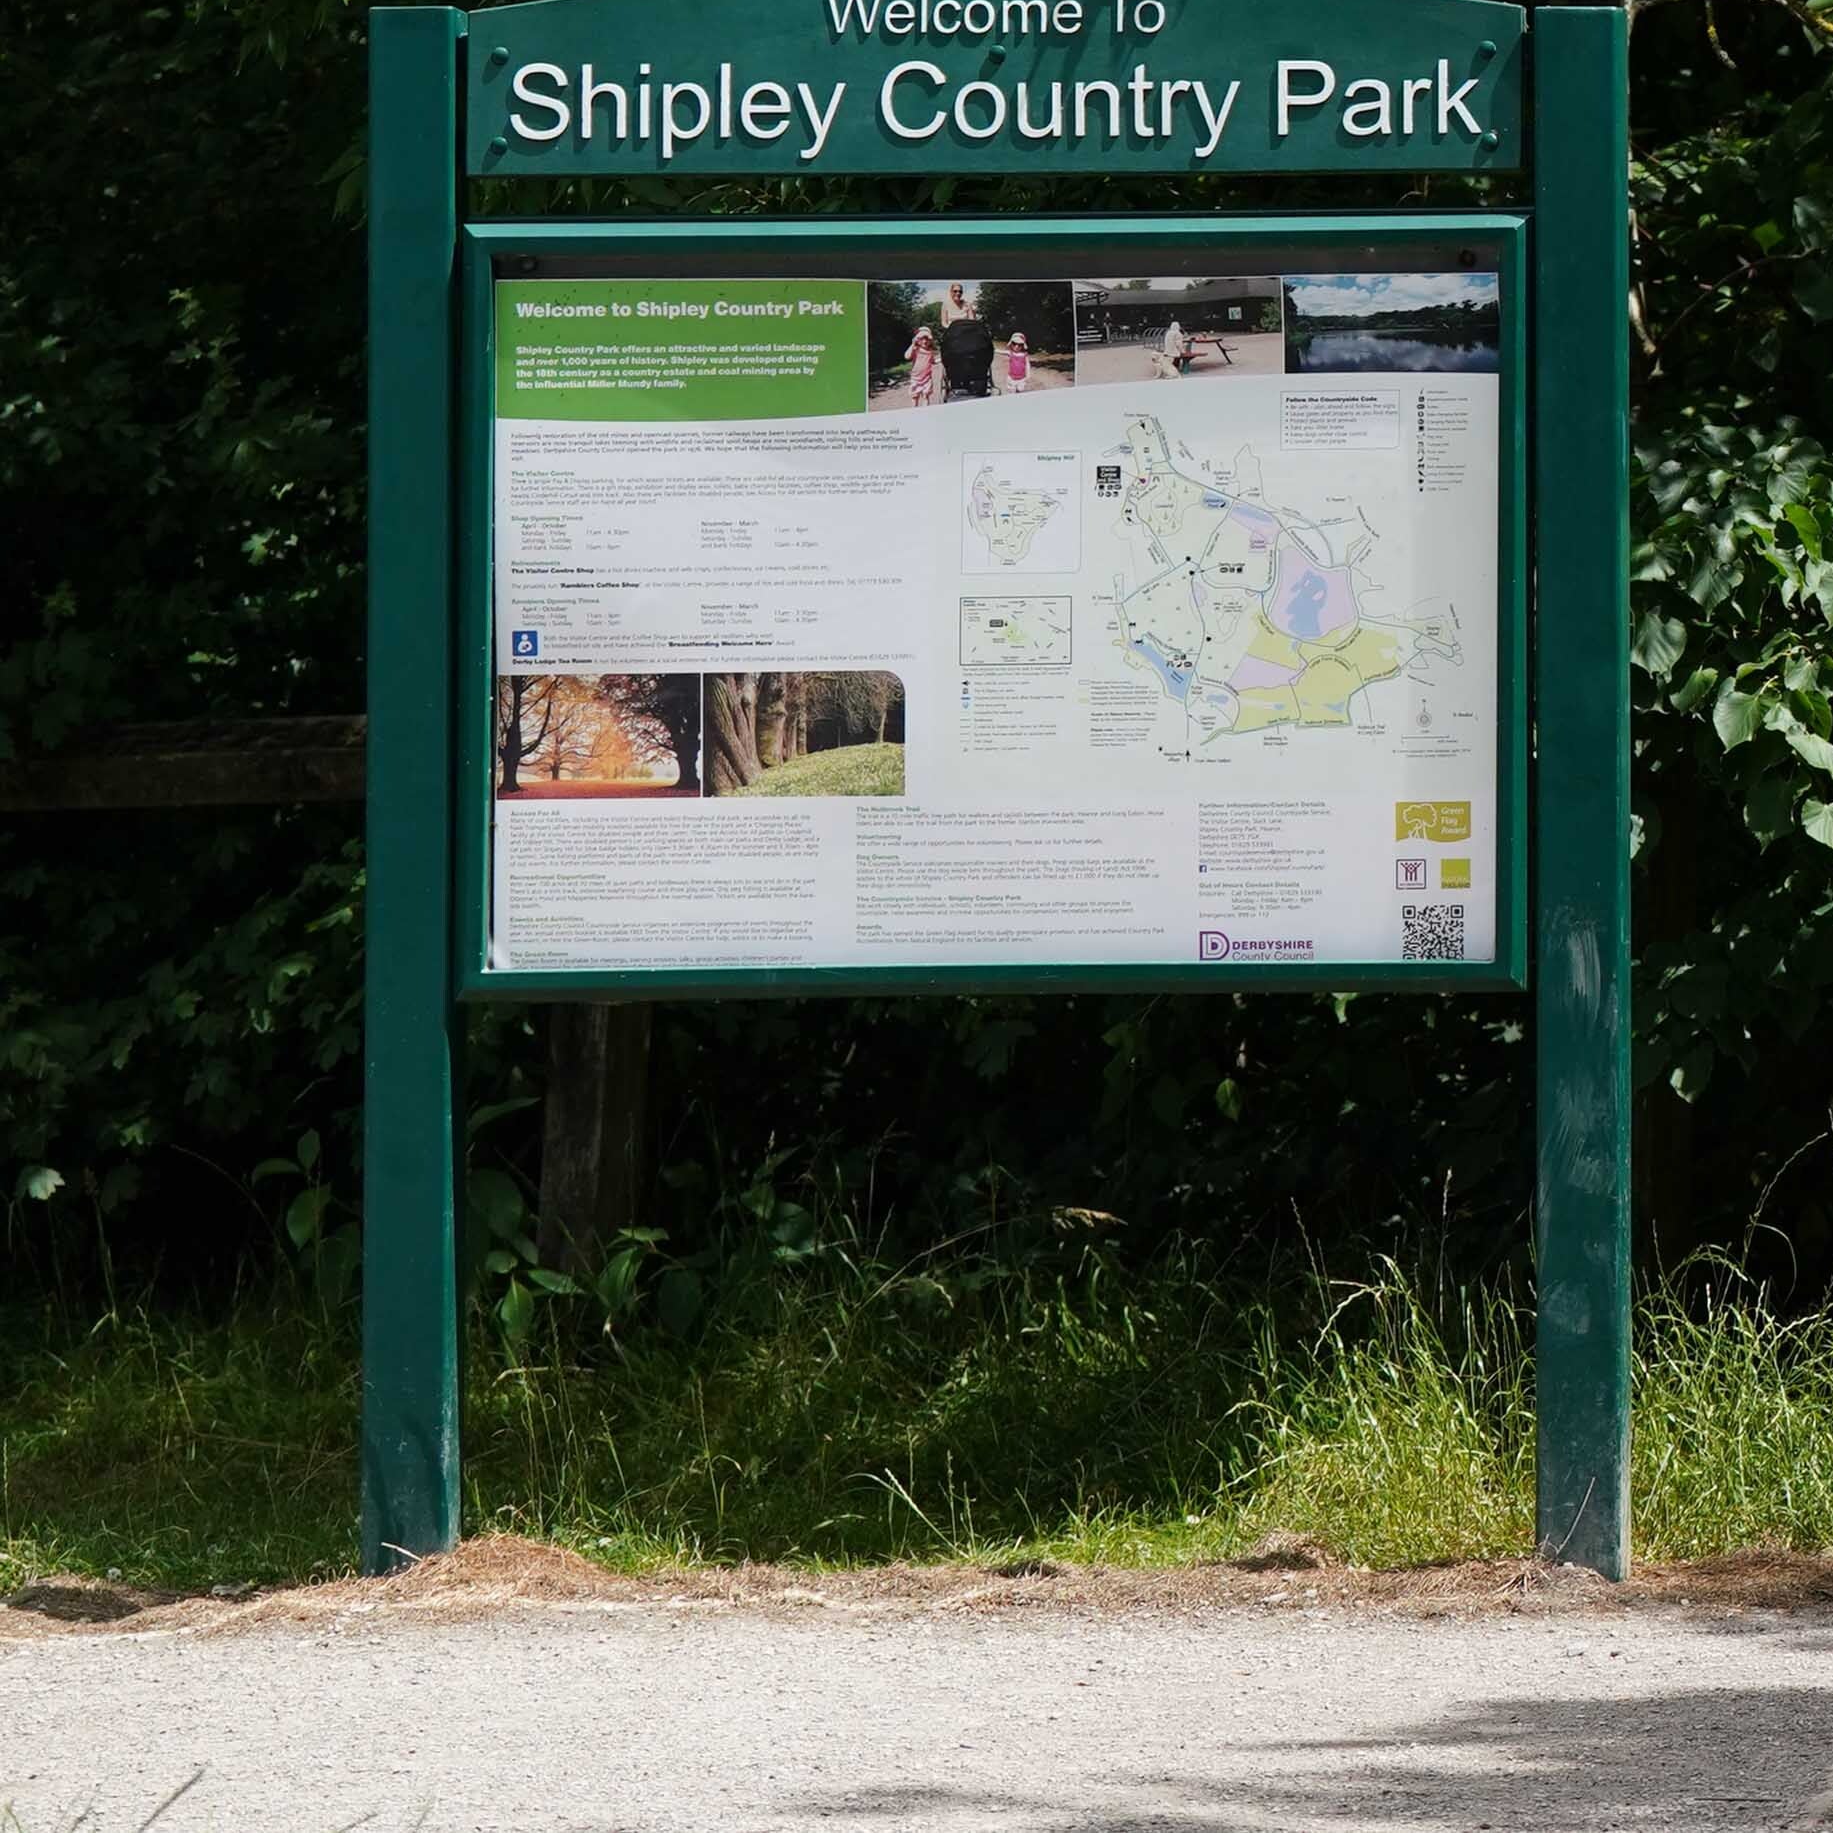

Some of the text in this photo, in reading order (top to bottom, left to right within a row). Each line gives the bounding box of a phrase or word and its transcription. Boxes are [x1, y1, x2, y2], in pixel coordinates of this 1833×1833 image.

[509, 59, 1480, 159] Shipley Country Park
[516, 301, 845, 320] Welcome to Shipley Country Park
[516, 346, 552, 355] Shipley
[554, 346, 594, 355] Country
[773, 344, 826, 354] landscape
[516, 358, 535, 366] and
[562, 357, 588, 368] 1,000
[590, 359, 617, 367] years
[619, 357, 630, 365] of
[631, 357, 668, 367] history.
[671, 356, 708, 367] Shipley
[732, 356, 784, 366] developed
[786, 356, 819, 366] during
[516, 369, 533, 378] the
[536, 369, 557, 378] 18th
[559, 369, 598, 379] century
[622, 368, 661, 379] country
[663, 368, 696, 376] estate
[697, 368, 716, 376] and
[718, 368, 740, 376] coal
[742, 367, 777, 378] mining
[803, 367, 816, 377] by
[516, 379, 688, 390] the influential Miller Mundy family.
[1232, 941, 1313, 950] DERBYSHIRE
[1232, 952, 1314, 961] County Council
